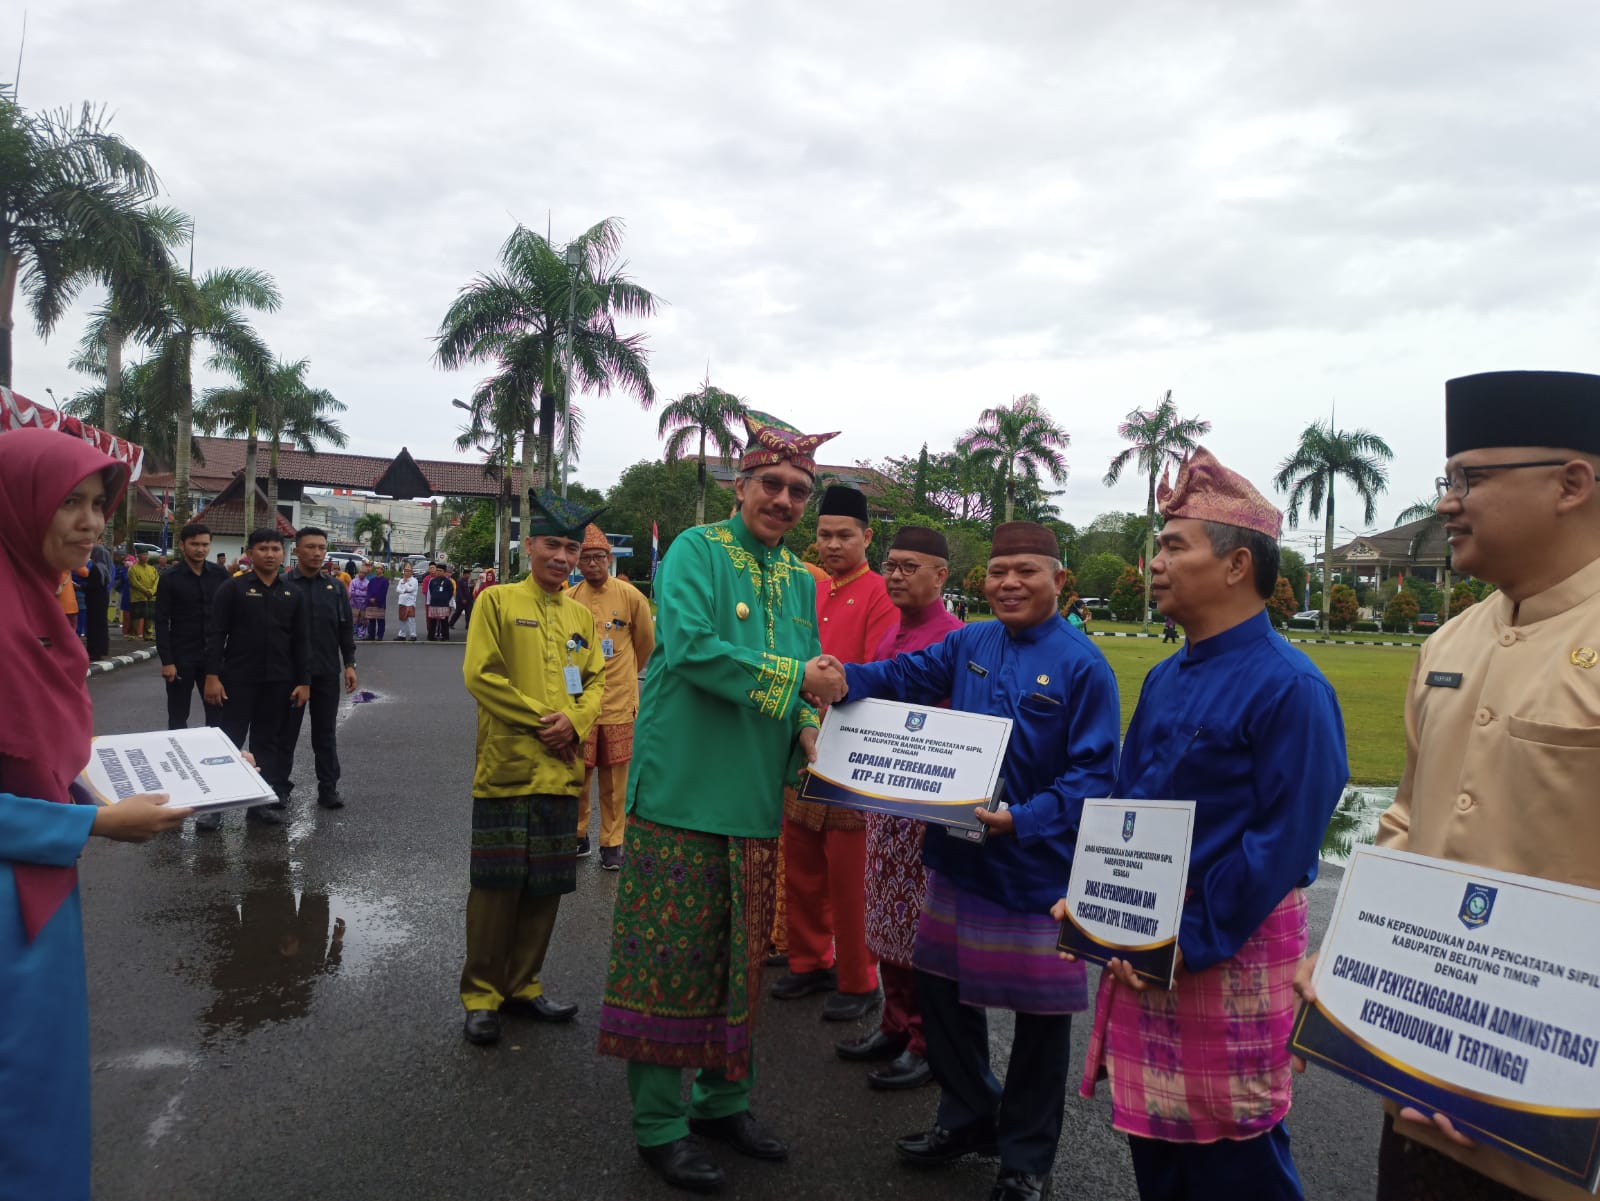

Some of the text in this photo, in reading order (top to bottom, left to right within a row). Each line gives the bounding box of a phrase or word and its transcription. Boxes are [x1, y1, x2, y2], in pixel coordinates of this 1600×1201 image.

[864, 736, 953, 755] KABUPATEN BANGKA TENGAH
[892, 748, 918, 756] DENGAN
[925, 739, 965, 750] PENCATATAN
[848, 752, 956, 779] CAPAIAN PEREKAMAN
[851, 768, 942, 793] KTP-EL TERTINGGI
[1085, 880, 1100, 897] DINAS
[1143, 891, 1157, 910] DAN
[1107, 908, 1121, 927] SIPIL
[1121, 912, 1158, 937] TERINOVATIF
[1359, 911, 1600, 988] DINAS KEPENDUDUKAN DAN PENCATATAN SIPIL
[1392, 935, 1540, 987] KABUPATEN BELITUNG TIMUR
[1434, 962, 1478, 984] DENGAN
[1332, 955, 1599, 1068] CAPAIAN PENYELENGGARAAN ADMINISTRASI
[1360, 1000, 1529, 1084] KEPENDUDUKAN TERTINGGI
